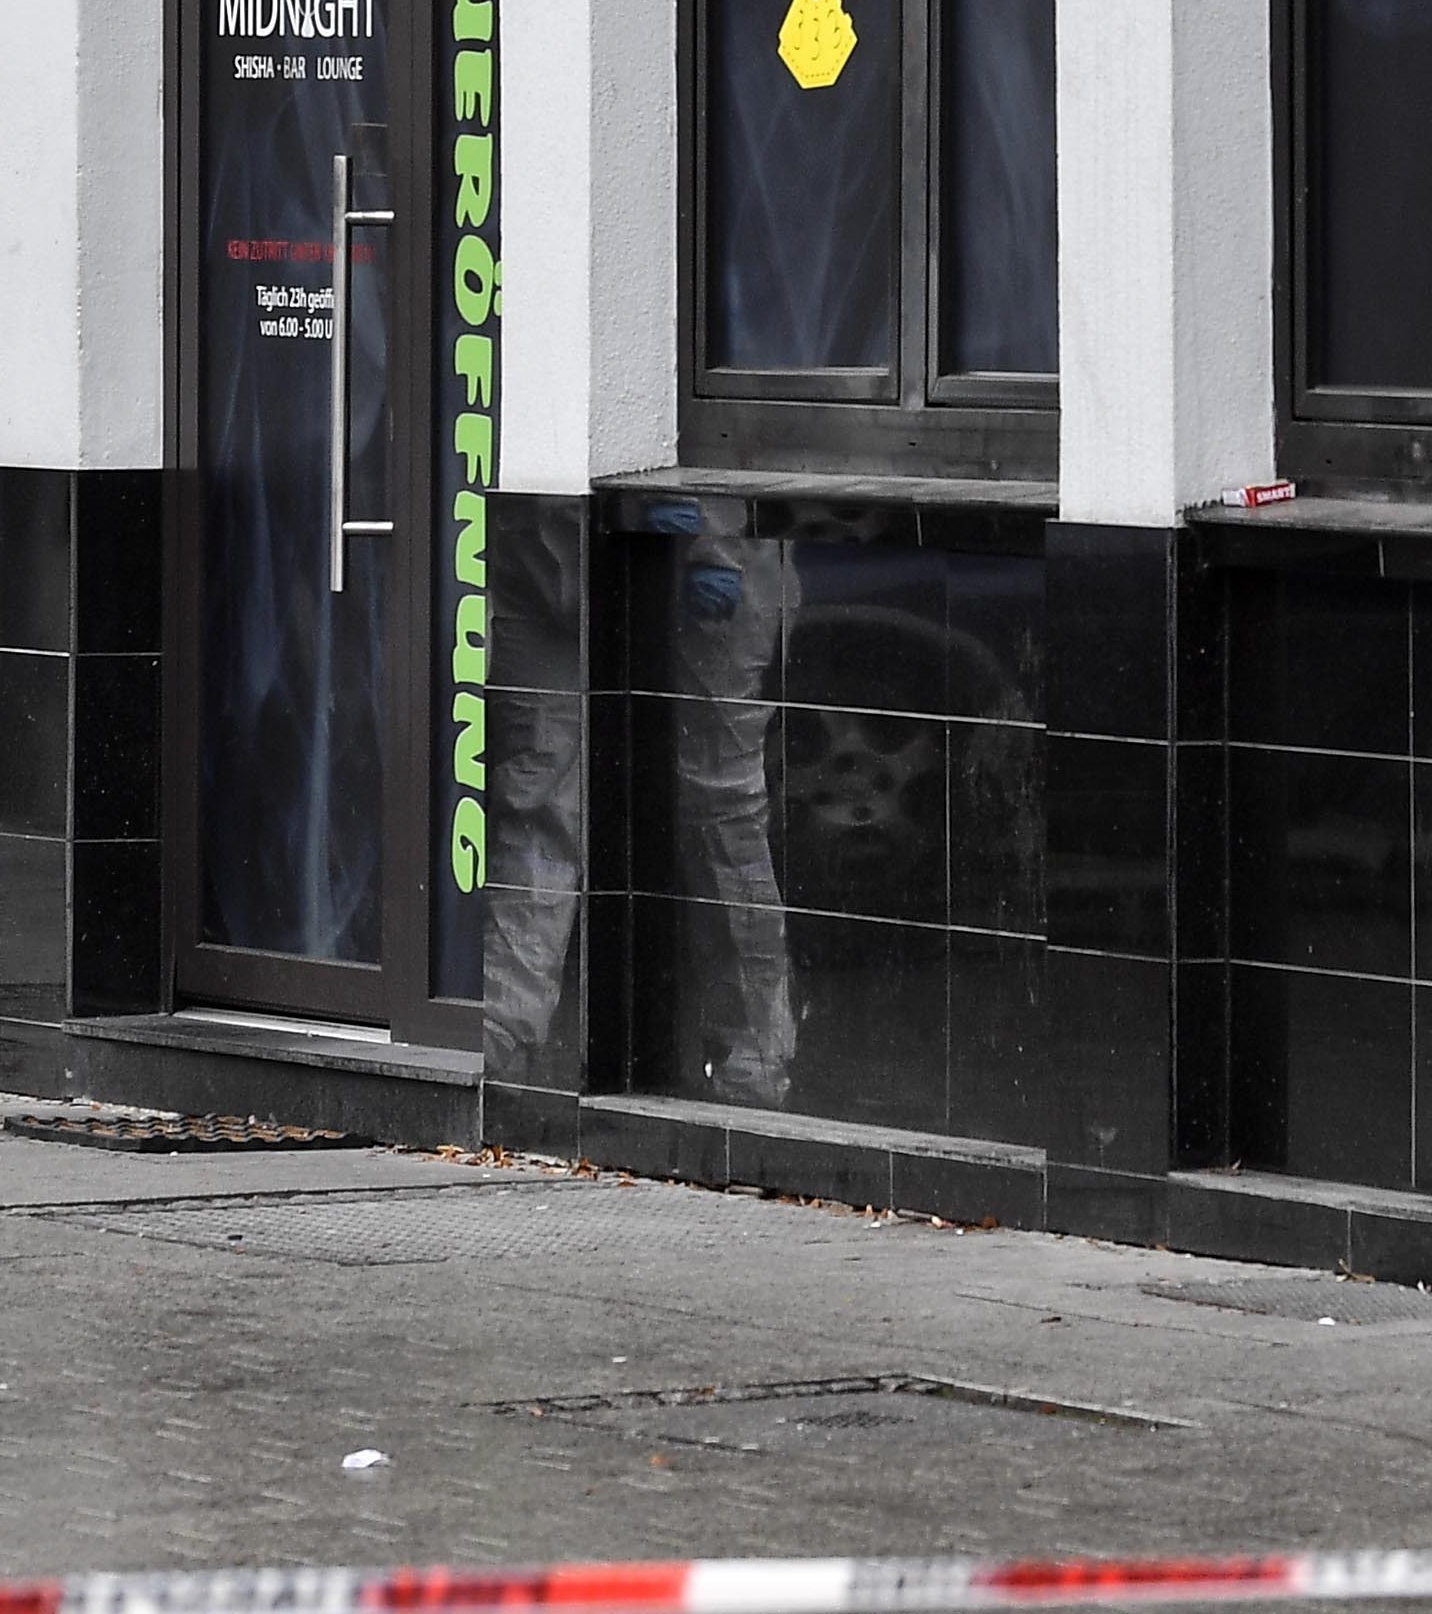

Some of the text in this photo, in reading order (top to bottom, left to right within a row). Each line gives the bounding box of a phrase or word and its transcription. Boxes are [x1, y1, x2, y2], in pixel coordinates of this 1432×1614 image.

[234, 55, 363, 80] SHISHA BAR LOUNGE
[289, 288, 307, 308] 23h
[308, 288, 334, 314] geöff
[260, 319, 278, 336] von
[278, 317, 298, 337] 6.00
[304, 318, 324, 339] 5.00
